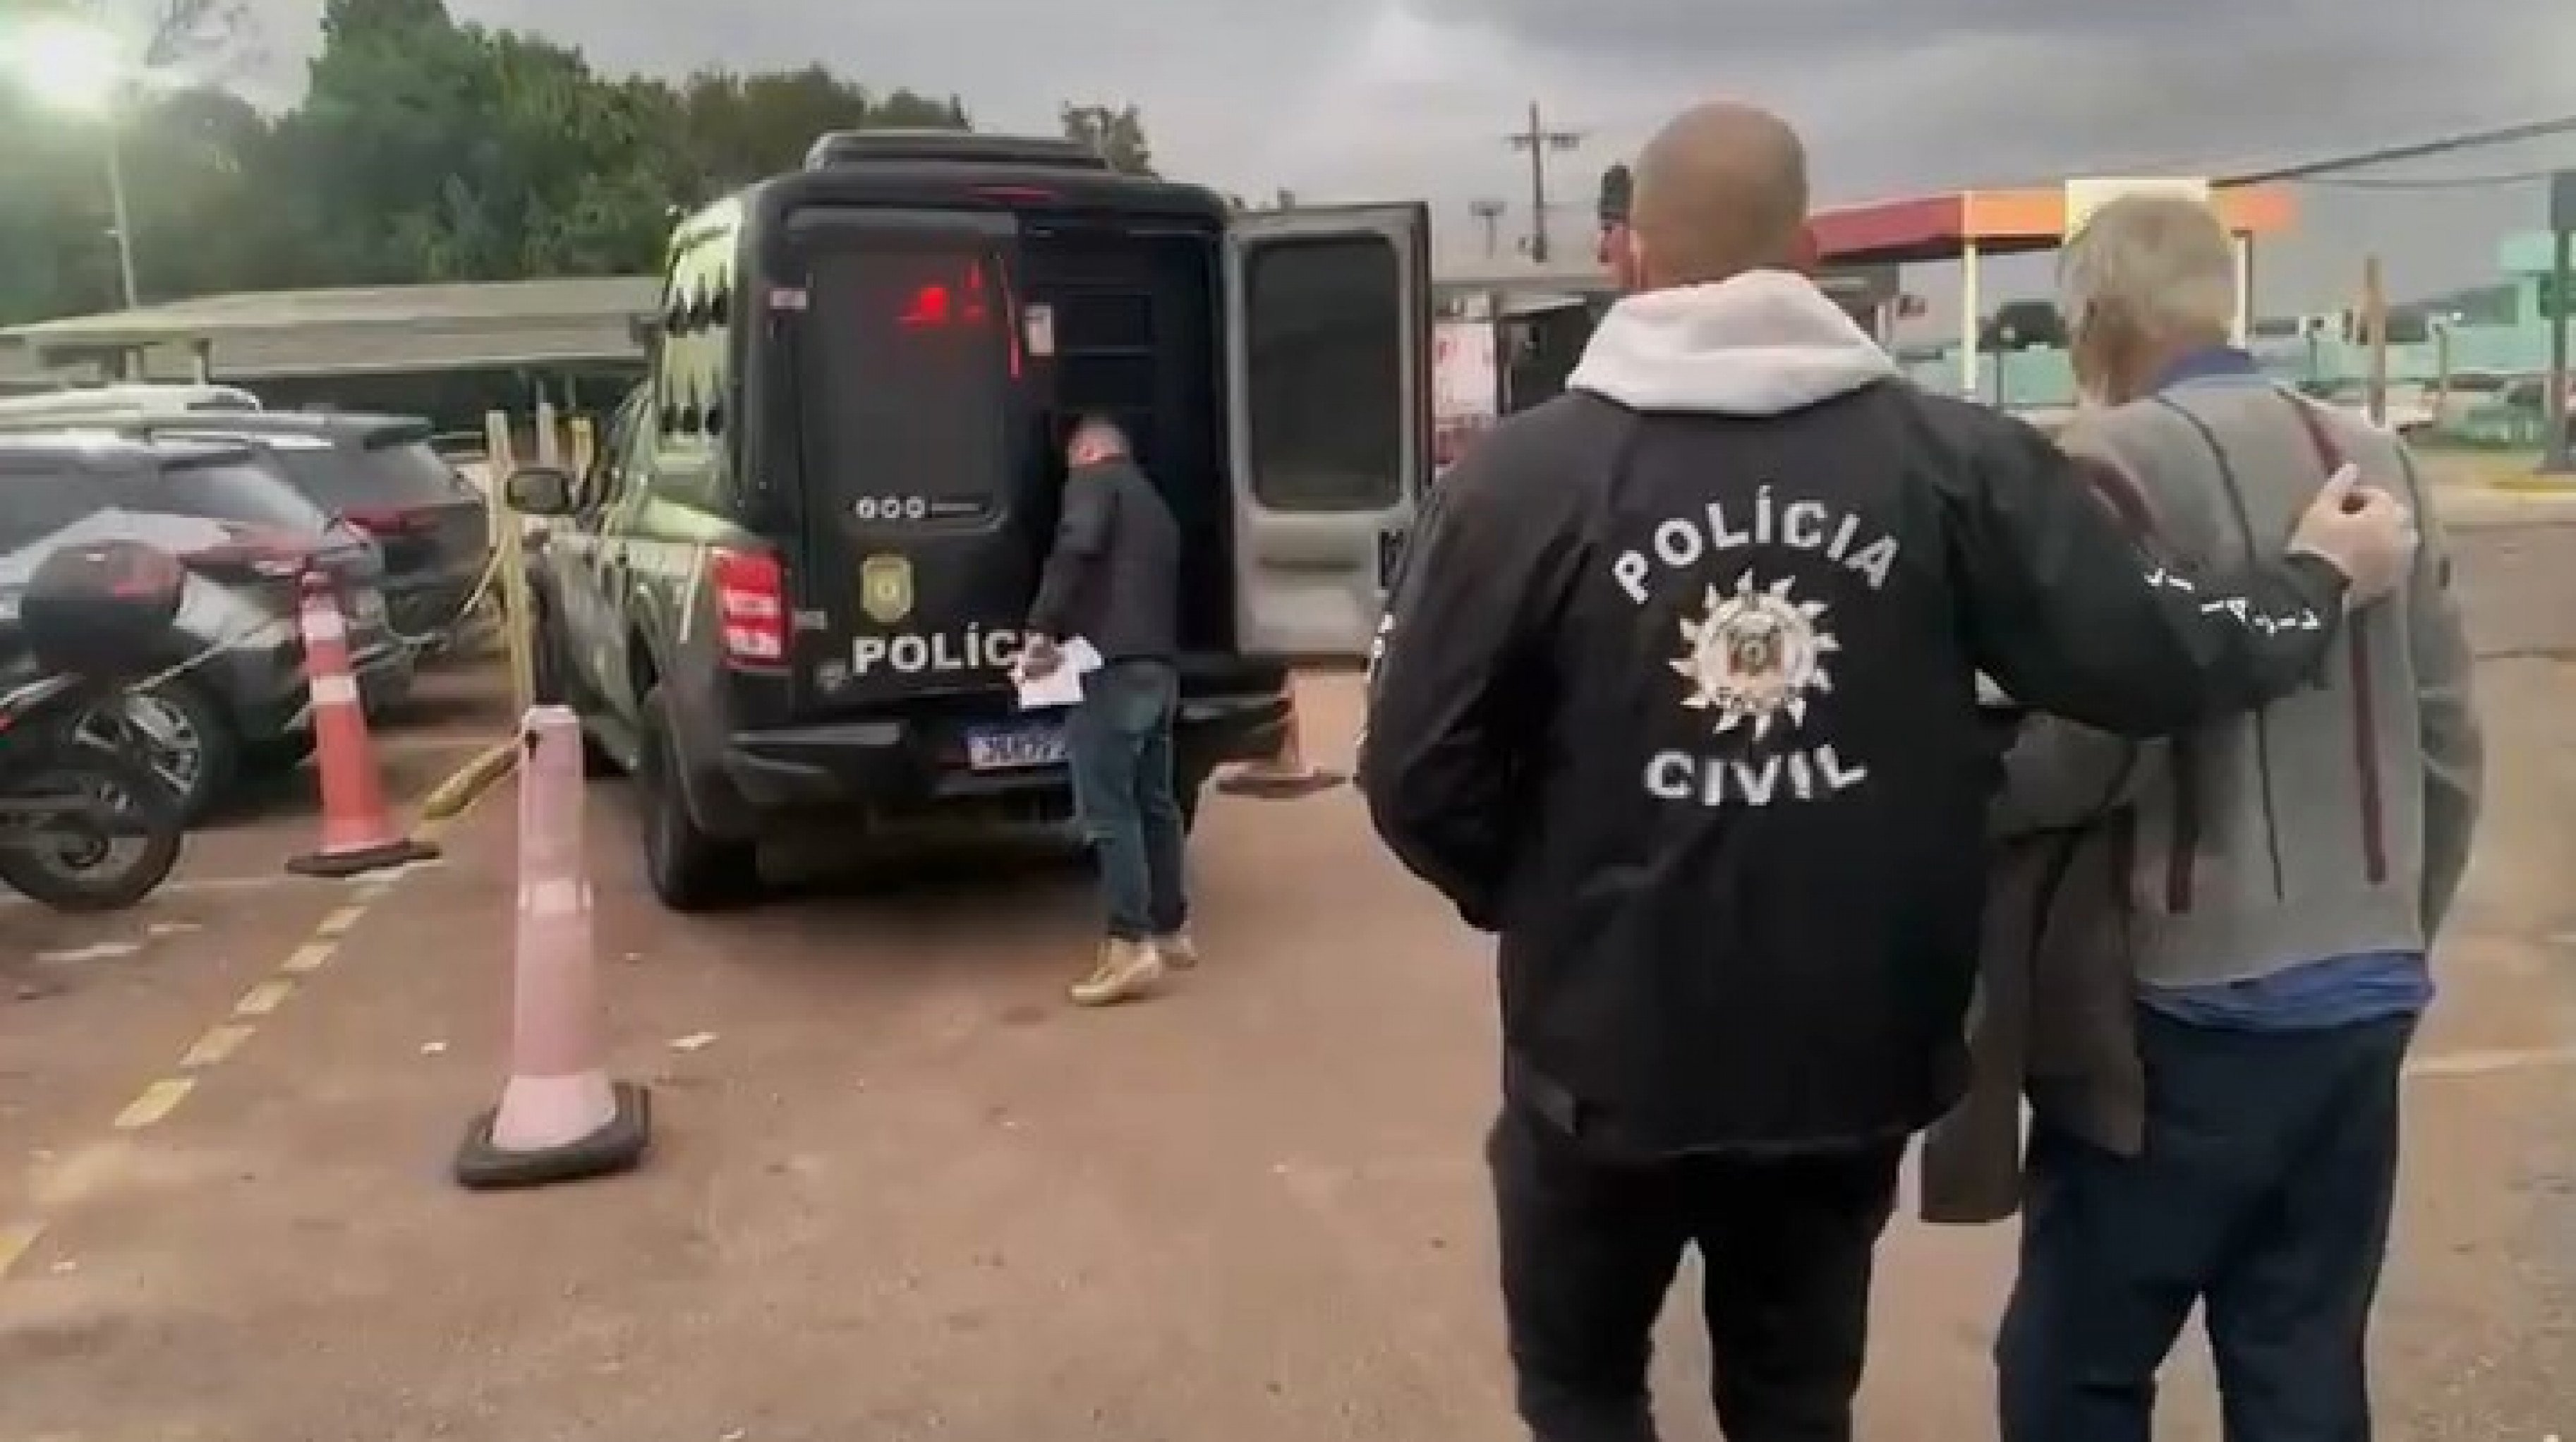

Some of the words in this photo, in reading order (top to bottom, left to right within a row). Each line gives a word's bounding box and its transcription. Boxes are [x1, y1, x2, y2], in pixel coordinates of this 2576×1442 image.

[1611, 485, 1900, 605] POLÍCIA
[852, 622, 1032, 674] POLÍC
[1643, 744, 1868, 806] CIVIL
